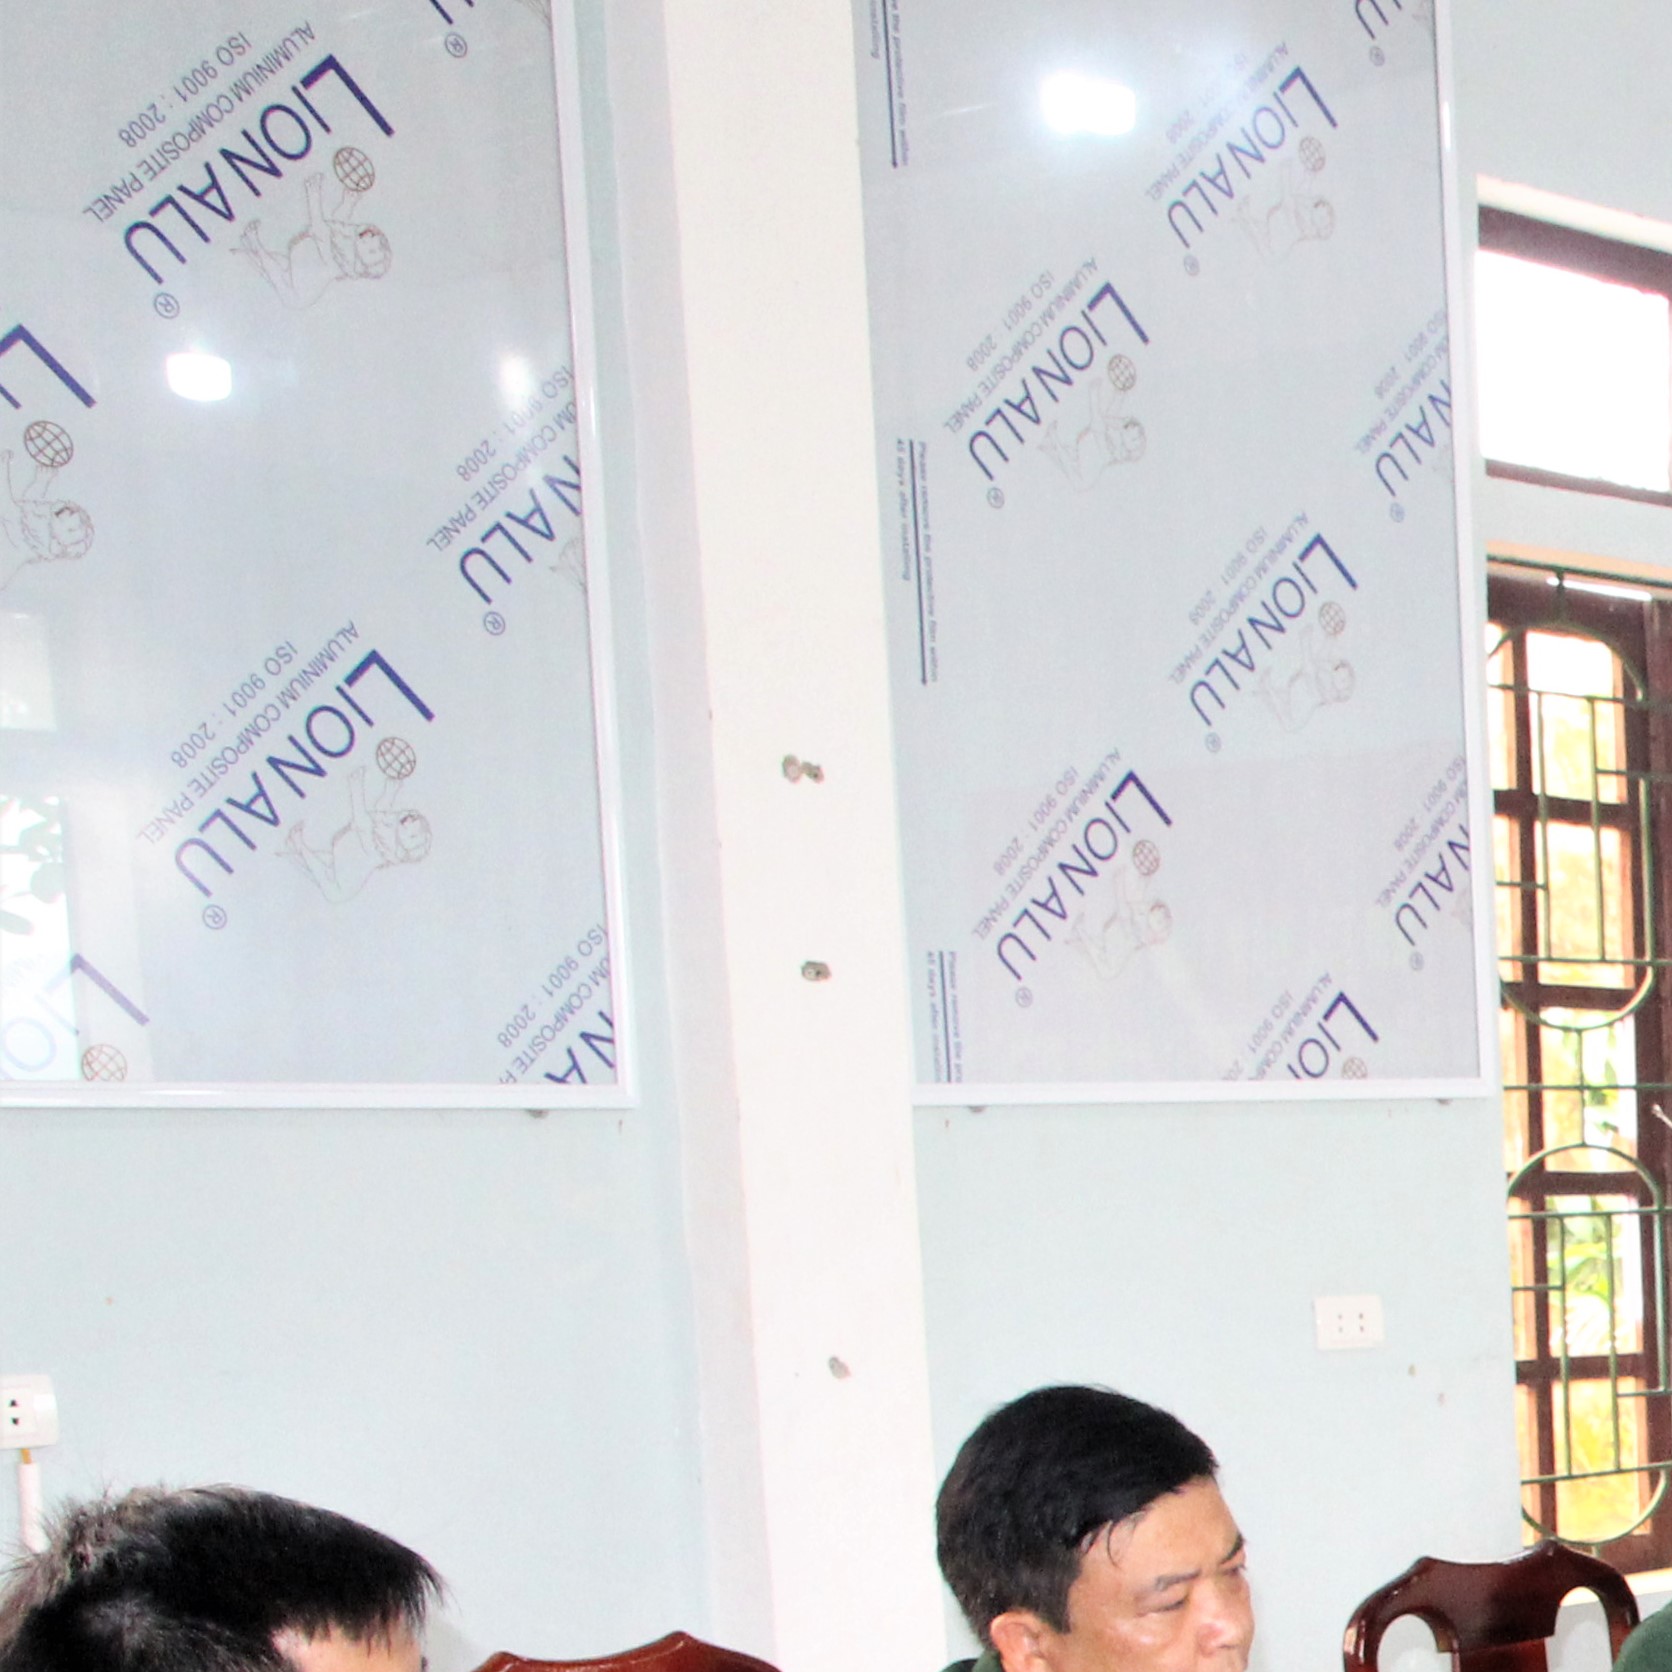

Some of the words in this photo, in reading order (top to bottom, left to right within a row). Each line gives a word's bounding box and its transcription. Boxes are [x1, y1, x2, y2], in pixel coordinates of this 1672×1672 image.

[214, 31, 252, 67] ISO
[228, 21, 311, 104] ALUMINIUM
[171, 59, 218, 103] 9001
[116, 103, 165, 148] 2008
[137, 92, 236, 181] COMPOSITE
[83, 171, 143, 225] PANEL
[454, 440, 496, 482] 2008
[426, 504, 476, 554] PANEL
[261, 640, 298, 678] ISO
[275, 621, 355, 710] ALUMINIUM
[222, 672, 266, 717] 9001
[169, 721, 214, 770] 2008
[187, 701, 282, 799] COMPOSITE
[970, 894, 1009, 941] PANEL
[541, 955, 578, 997] 9001
[496, 1005, 536, 1048] 2008
[513, 982, 591, 1074] COMPOSITE
